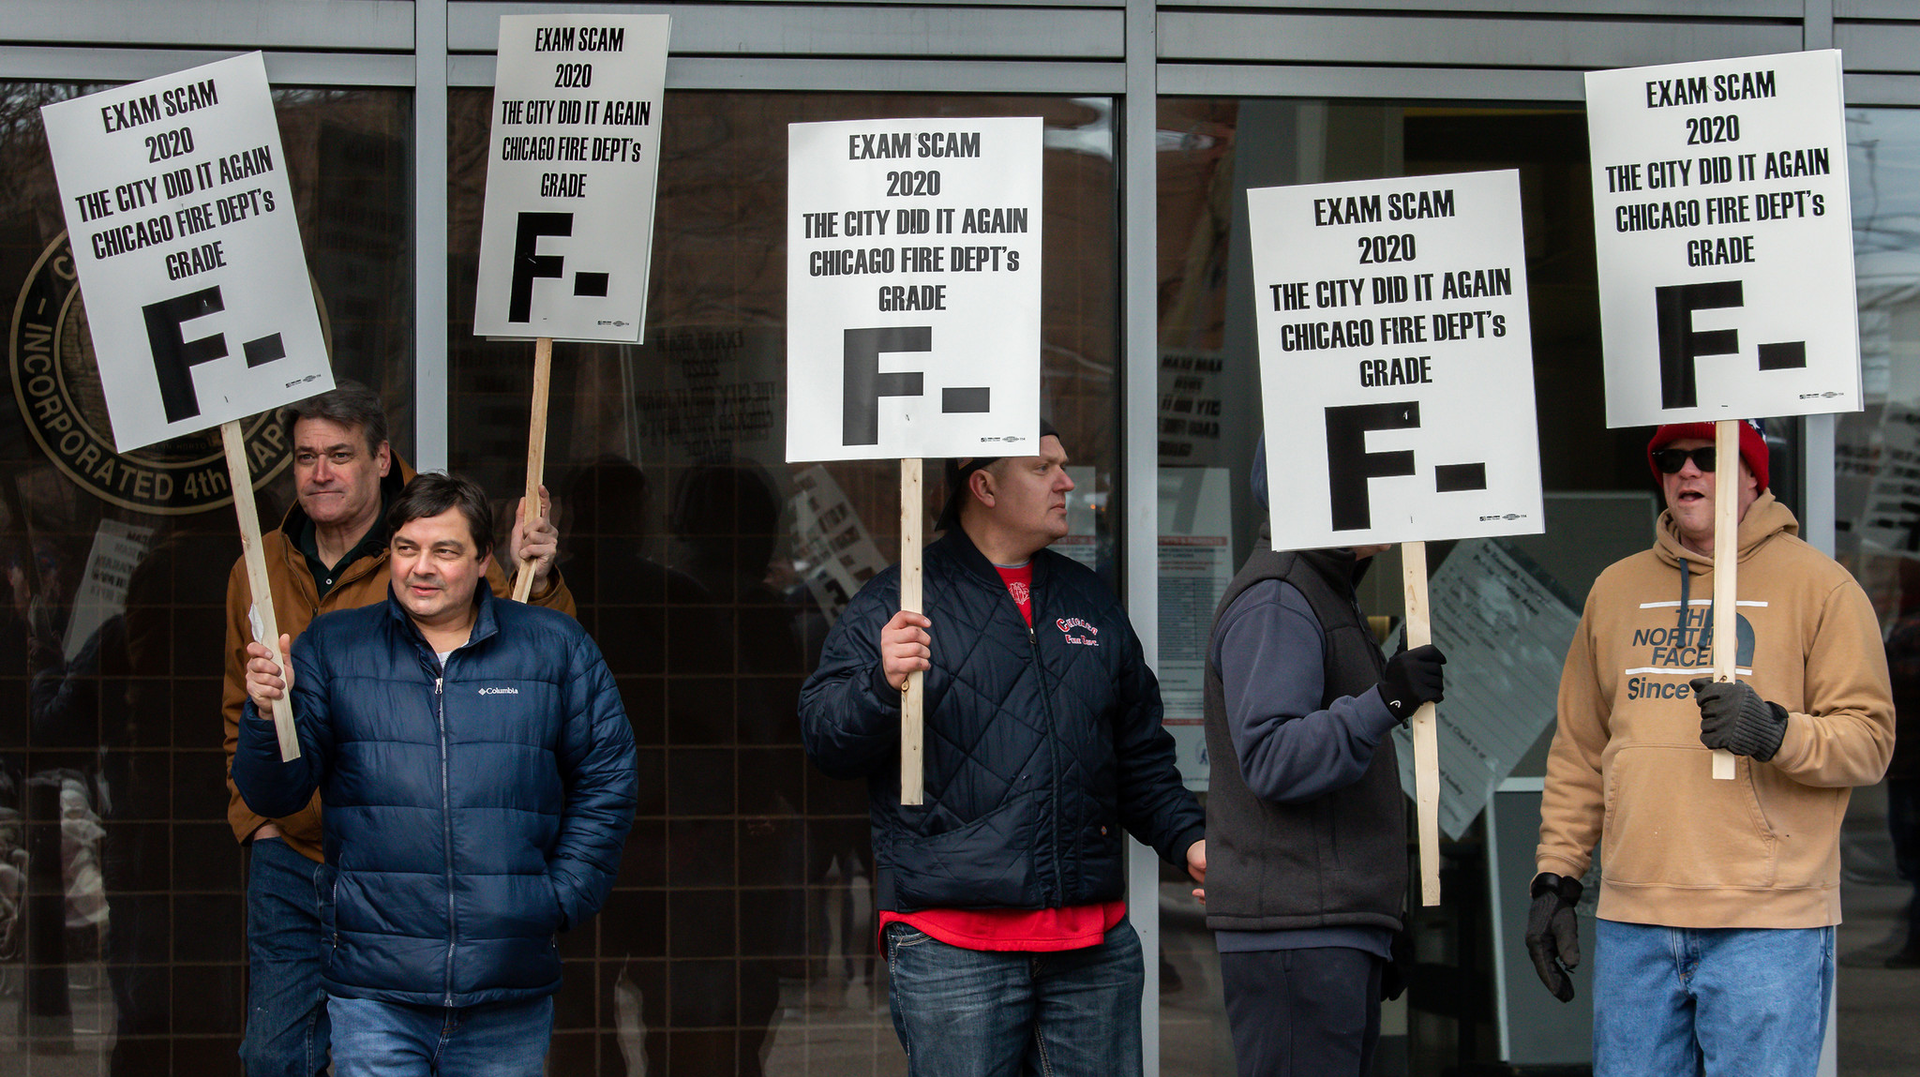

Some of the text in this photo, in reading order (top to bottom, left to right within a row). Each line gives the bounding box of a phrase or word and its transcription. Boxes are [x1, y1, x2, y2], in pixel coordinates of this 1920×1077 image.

[535, 27, 624, 52] EXAM SCAM
[555, 64, 592, 88] 2020
[1646, 71, 1775, 108] EXAM SCAM
[101, 79, 218, 133] EXAM SCAM
[502, 100, 651, 125] THE CITY DID IT AGAIN
[145, 127, 194, 163] 2020
[1687, 115, 1739, 145] 2020
[502, 137, 641, 162] CHICAGO FIRE DEPT's
[850, 133, 980, 159] EXAM SCAM
[75, 145, 273, 222] THE CITY DID IT AGAIN
[887, 171, 940, 196] 2020
[1606, 148, 1829, 192] THE CITY DID IT AGAIN
[541, 173, 587, 198] GRADE
[803, 208, 1027, 238] THE CITY DID IT AGAIN
[1314, 190, 1455, 226] EXAM SCAM
[1616, 190, 1824, 232] CHICAGO FIRE DEPT's
[92, 188, 275, 259] CHICAGO FIRE DEPT's
[166, 241, 227, 280] GRADE
[810, 247, 1019, 276] CHICAGO FIRE DEPT's
[1358, 234, 1416, 264] 2020
[1688, 236, 1755, 267] GRADE
[879, 285, 946, 311] GRADE
[1270, 268, 1511, 311] THE CITY DID IT AGAIN
[1281, 311, 1506, 351] CHICAGO FIRE DEPT's
[1360, 356, 1432, 387] GRADE
[23, 322, 287, 500] INCORPORATED 4th AR
[1675, 608, 1714, 627] TH
[1651, 646, 1710, 667] FACE
[486, 687, 519, 695] Columbia
[1627, 677, 1690, 700] Since
